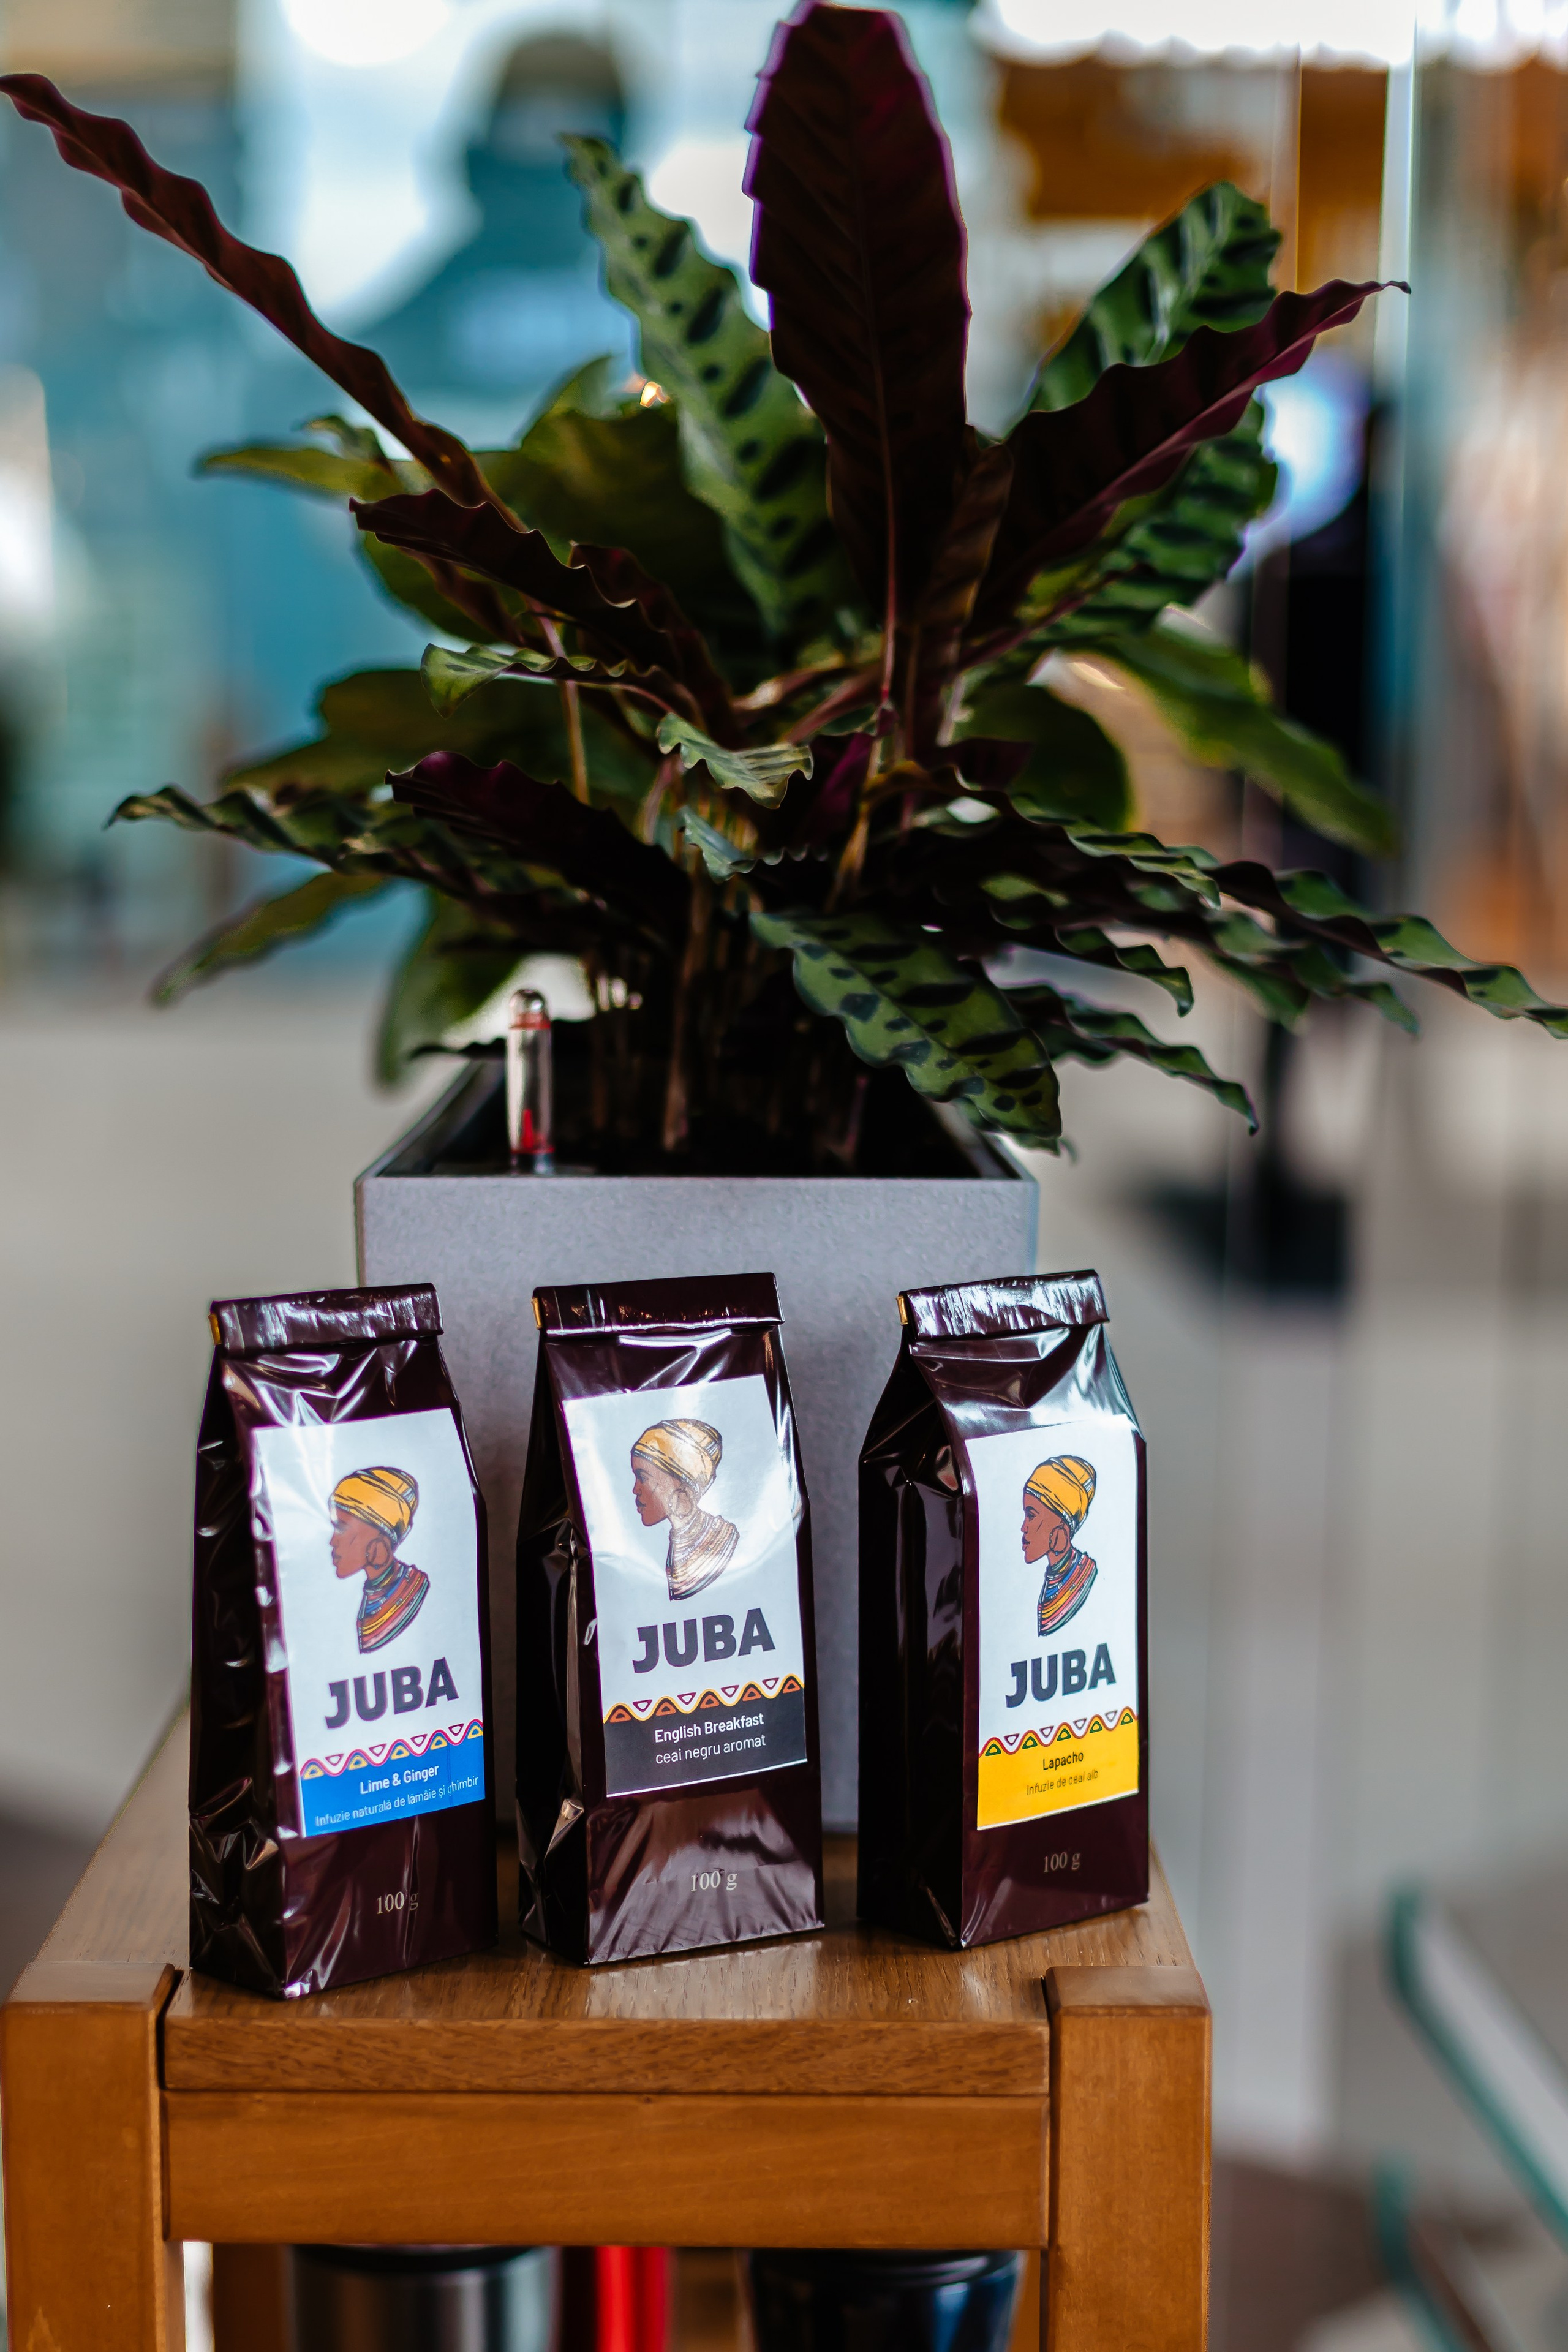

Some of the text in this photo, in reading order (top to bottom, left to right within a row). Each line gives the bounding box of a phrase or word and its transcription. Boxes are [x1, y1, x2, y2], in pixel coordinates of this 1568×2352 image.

[631, 1607, 776, 1673] JUBA
[1005, 1642, 1117, 1708] JUBA
[325, 1656, 459, 1729] JUBA
[654, 1713, 764, 1743] English Breakfast
[655, 1734, 766, 1764] ceai negru aromat
[1042, 1751, 1084, 1771] Lapacho
[360, 1765, 439, 1795] Lime & Ginger
[1027, 1768, 1099, 1795] Infuzie de ceai alb
[315, 1811, 350, 1827] Infuzie
[353, 1799, 392, 1819] naturală
[394, 1796, 405, 1808] de
[407, 1788, 437, 1805] lămâie
[1043, 1852, 1080, 1873] 100 g
[691, 1871, 737, 1891] 100 g
[377, 1891, 418, 1914] 100 g
